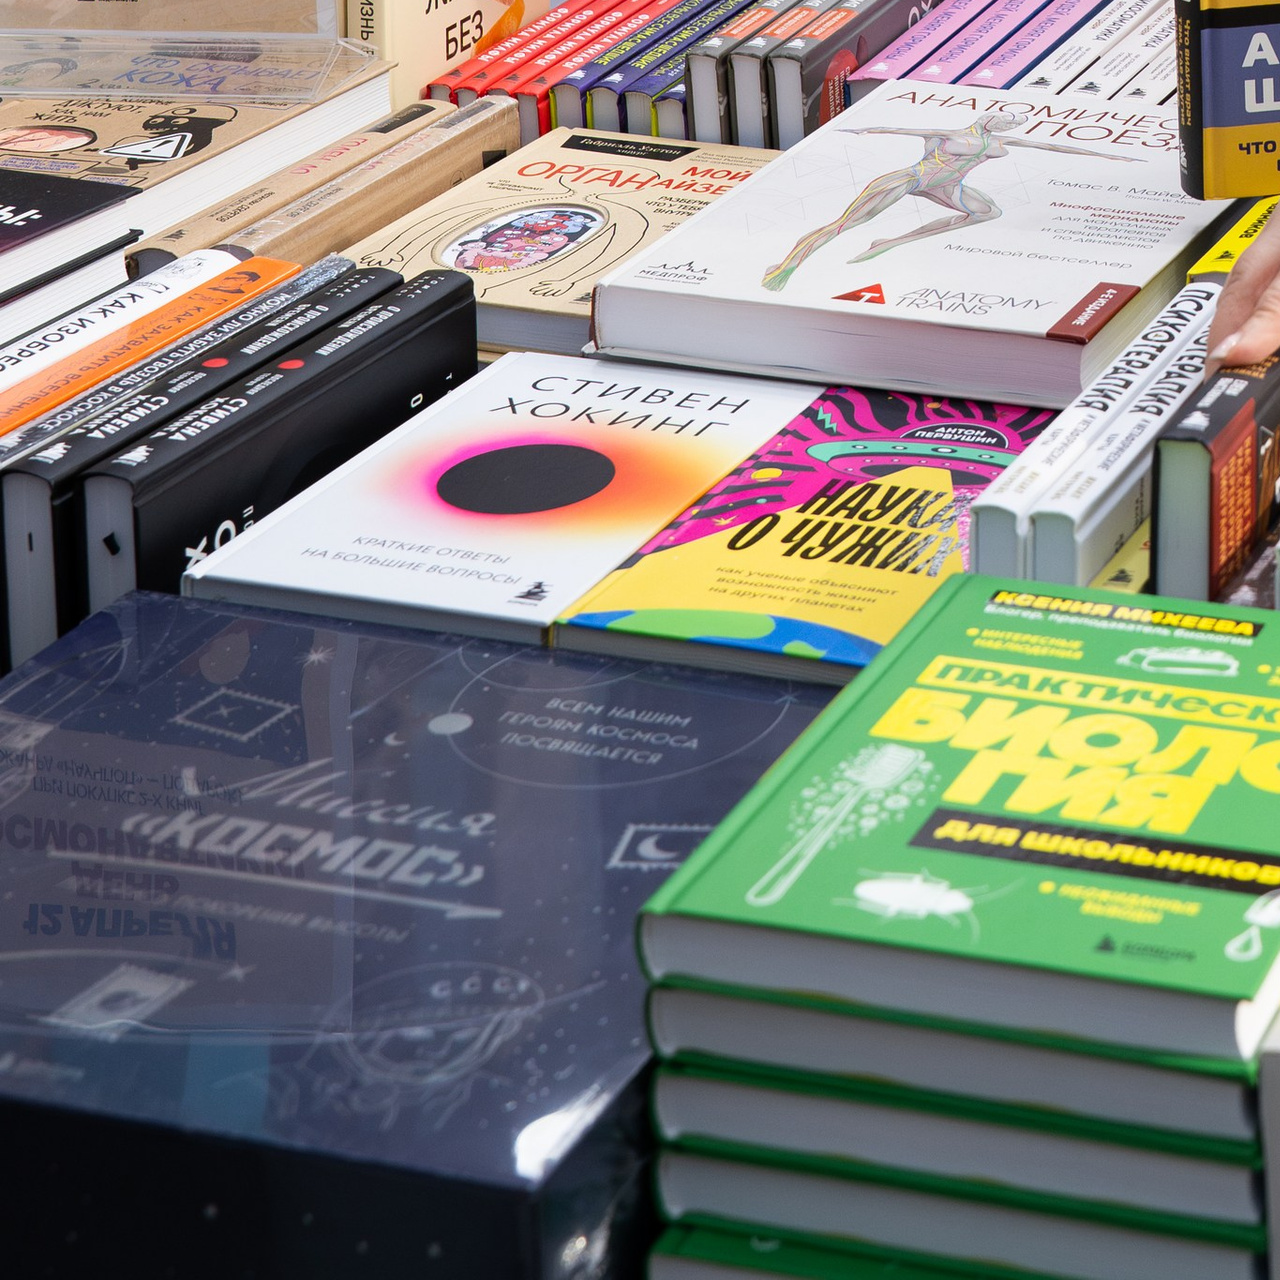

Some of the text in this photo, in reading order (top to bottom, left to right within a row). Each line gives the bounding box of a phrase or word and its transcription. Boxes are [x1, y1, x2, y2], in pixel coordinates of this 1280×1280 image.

[445, 9, 484, 61] БЕЗ
[116, 68, 228, 93] КОЖА
[578, 138, 636, 151] Габриэль
[1238, 139, 1277, 156] ЧТО
[681, 166, 754, 183] МОЙ
[1048, 178, 1104, 191] Томас
[1050, 201, 1187, 221] Миофасциальные
[1090, 213, 1181, 227] меридианы
[1054, 228, 1162, 244] специалистов
[1083, 218, 1175, 233] мануальных
[1083, 224, 1167, 239] терапевтов
[943, 244, 1134, 270] Мировой бестселлер
[638, 268, 709, 282] МЕДПРОФ
[98, 291, 144, 319] КАК
[895, 296, 992, 317] TRAINS
[898, 287, 1053, 311] ANATOMY
[37, 291, 292, 433] МОЖНО КОСМОСЕ
[1072, 288, 1206, 414] ПСИХОТЕРАПИЯ
[527, 374, 751, 416] СТИВЕН
[86, 395, 169, 440] СТИВЕНА
[489, 395, 730, 438] ХОКИНГ
[914, 430, 999, 445] ПЕРВУШИН
[934, 425, 987, 438] АНТОН
[727, 513, 781, 551] О
[352, 535, 513, 565] КРАТКИЕ ОТВЕТЫ
[300, 547, 523, 585] НА БОЛЬШИЕ ВОПРОСЫ
[714, 565, 900, 597] как ученые объясняют
[714, 577, 877, 605] возможность жизни
[729, 588, 866, 614] других планетах
[993, 590, 1256, 638] КСЕНИЯ МИХЕЕВА
[545, 697, 692, 728] ВСЕМ НАШИМ
[498, 710, 699, 750] ГЕРОЯМ КОСМОСА
[500, 731, 663, 765] ПОСВЯЩАЕТСЯ
[932, 818, 1015, 849] ДЛЯ
